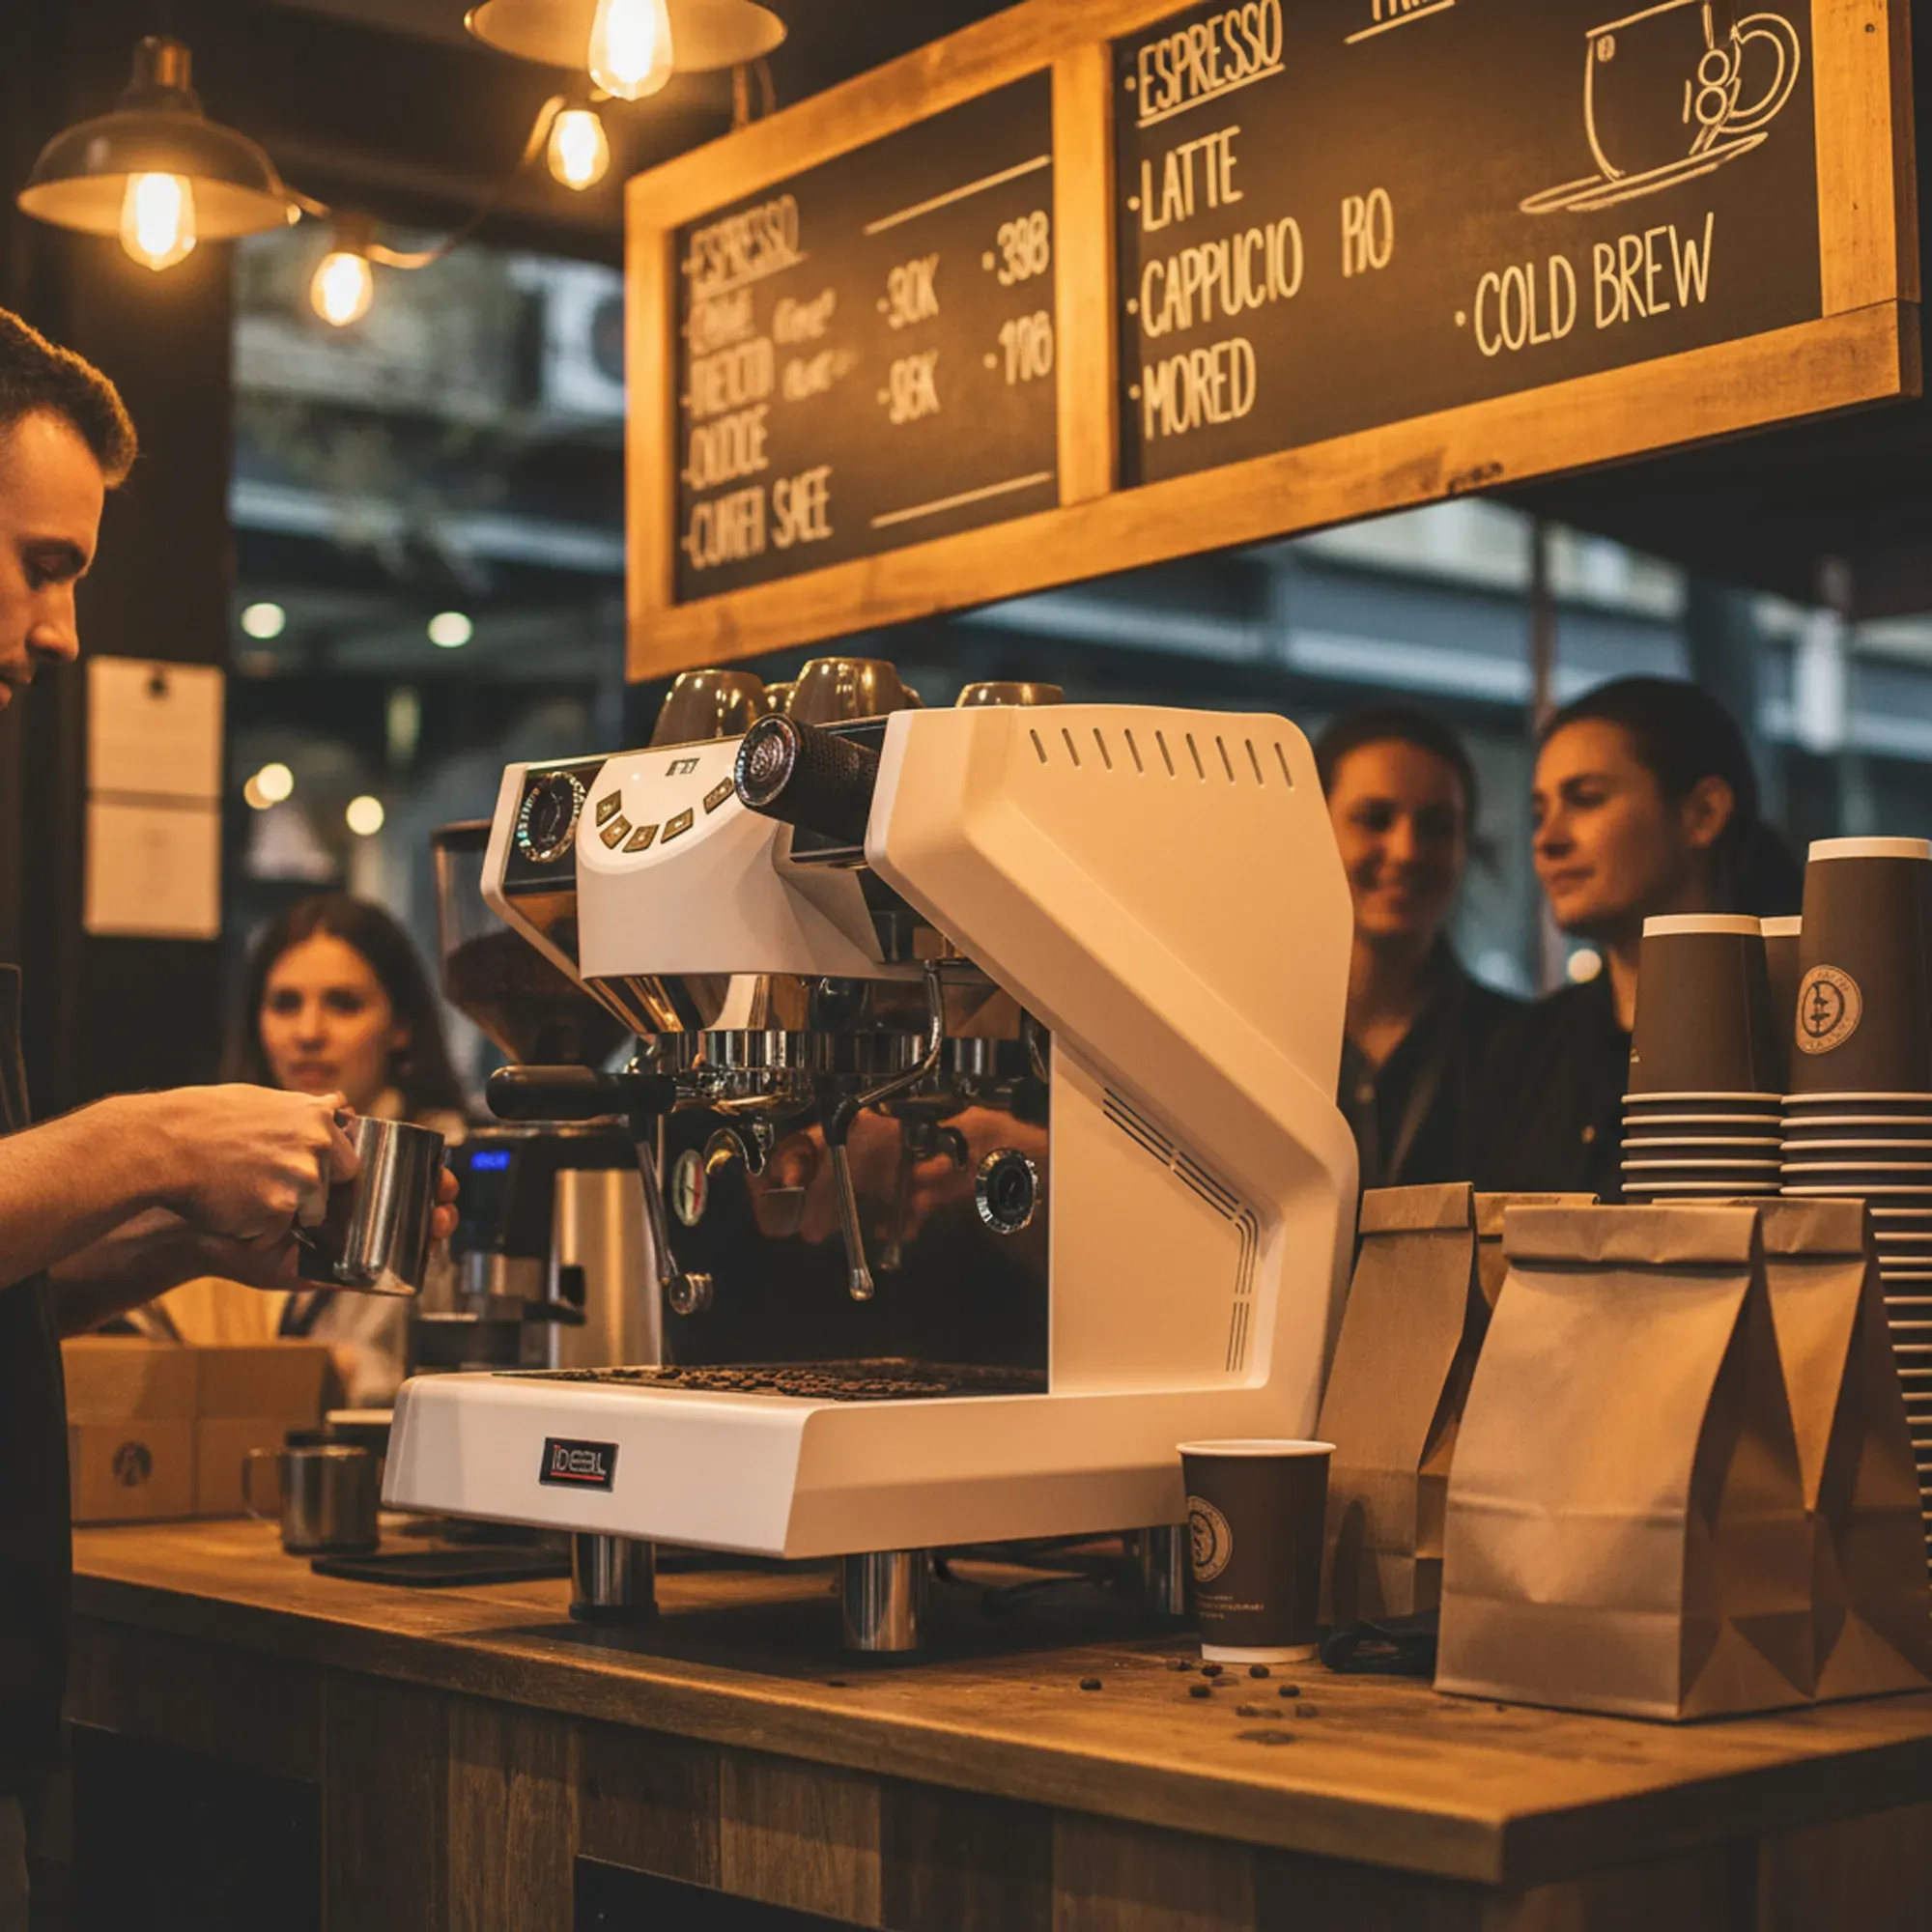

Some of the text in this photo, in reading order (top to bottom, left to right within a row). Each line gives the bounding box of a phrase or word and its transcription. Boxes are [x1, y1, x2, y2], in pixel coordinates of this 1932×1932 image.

[1138, 0, 1283, 117] ESPRESSO
[1141, 126, 1243, 231] LATTE
[1141, 217, 1304, 338] CAPPUCIO
[1474, 212, 1714, 356] COLD BREW
[1144, 338, 1257, 440] MORED
